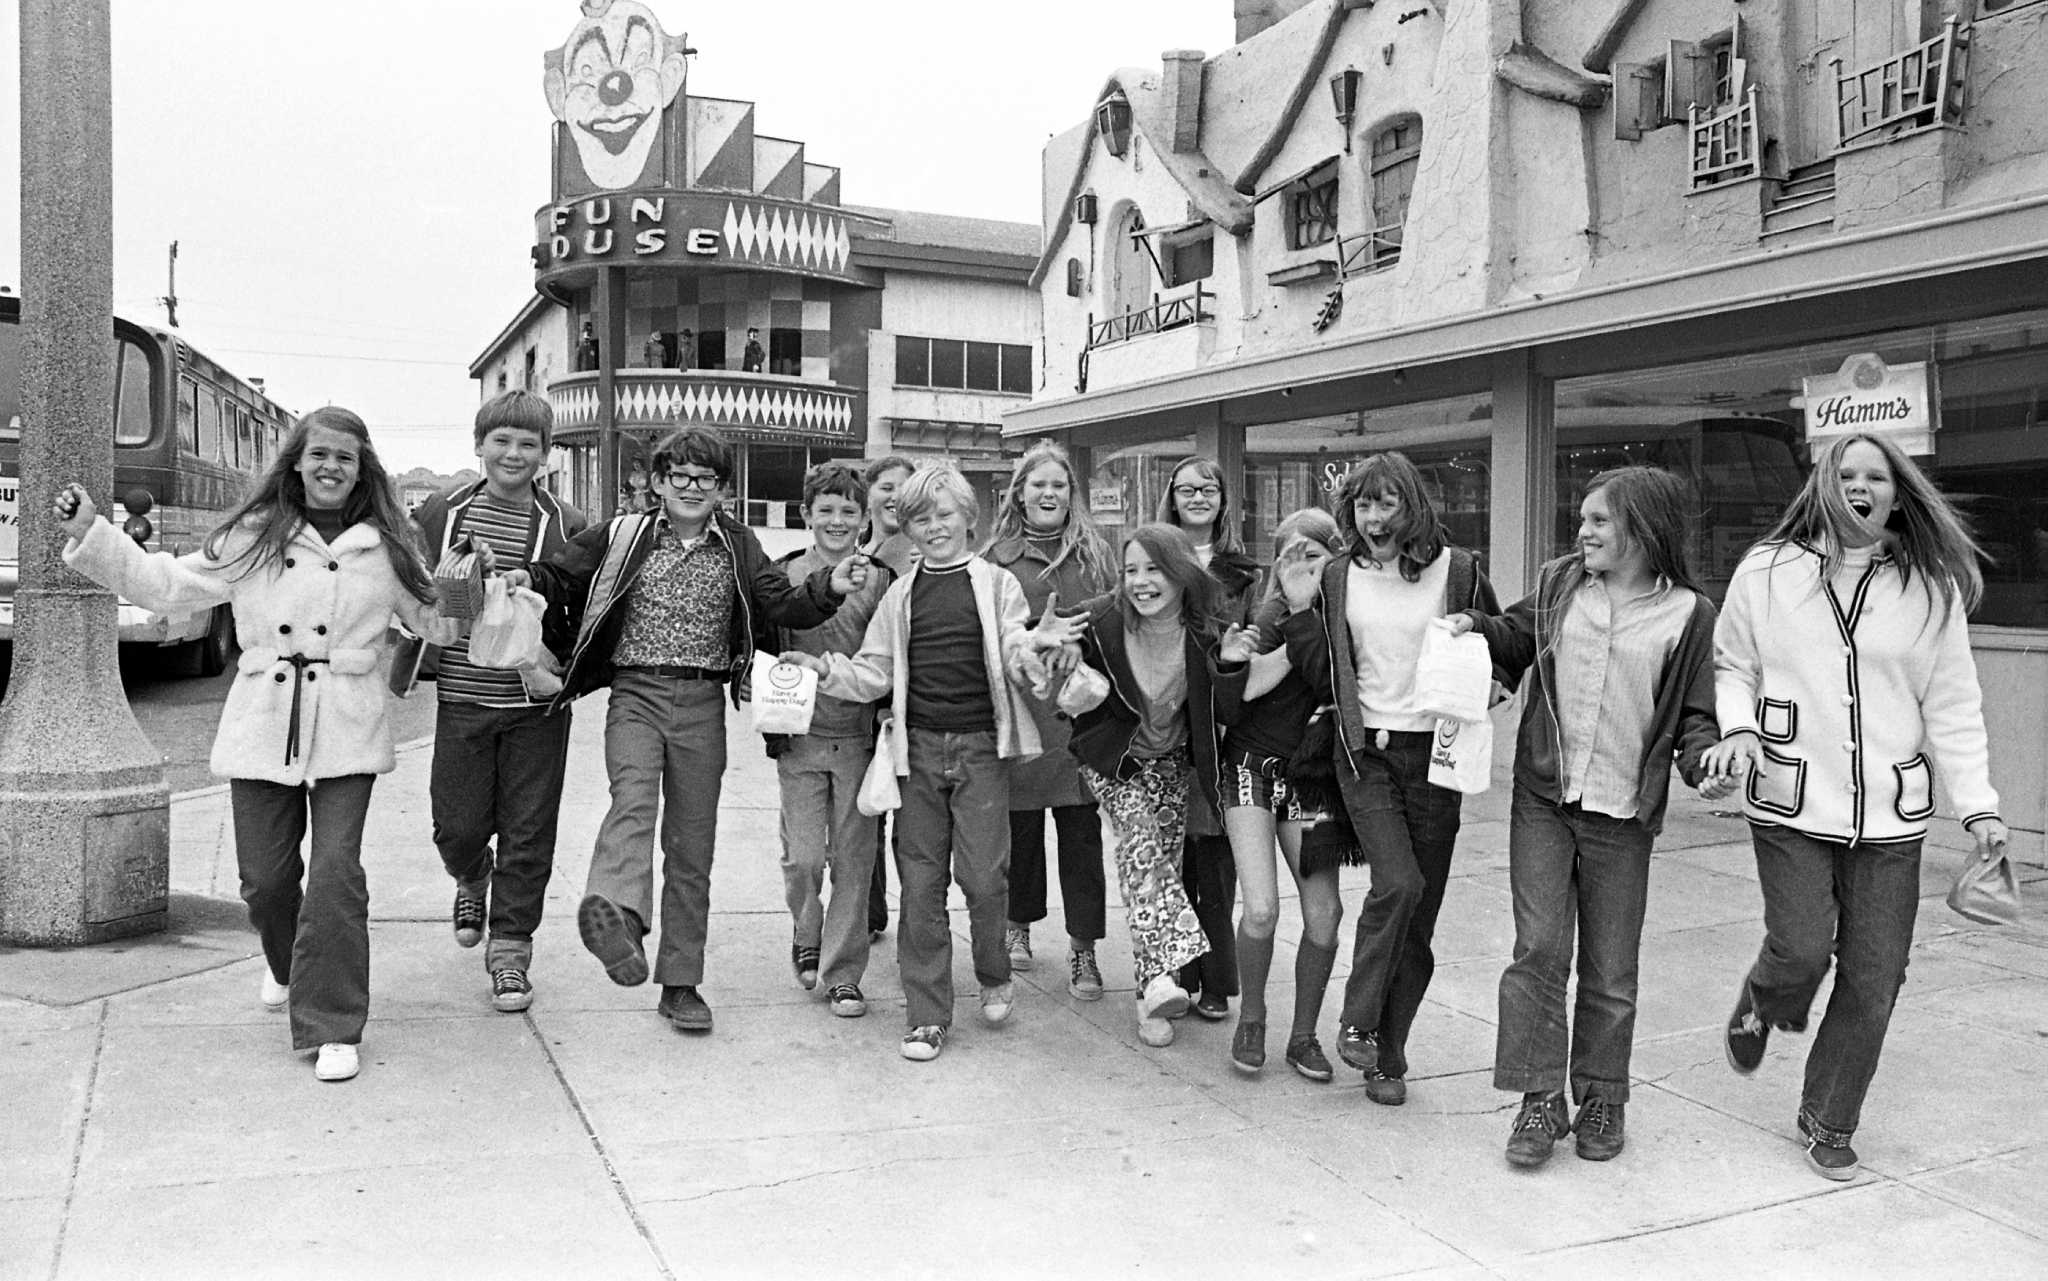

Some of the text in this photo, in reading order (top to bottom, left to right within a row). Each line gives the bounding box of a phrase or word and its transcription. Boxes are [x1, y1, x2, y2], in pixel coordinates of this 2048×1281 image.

[550, 198, 664, 232] FUN
[552, 228, 720, 258] OUSE
[1816, 395, 1911, 428] Hamm's
